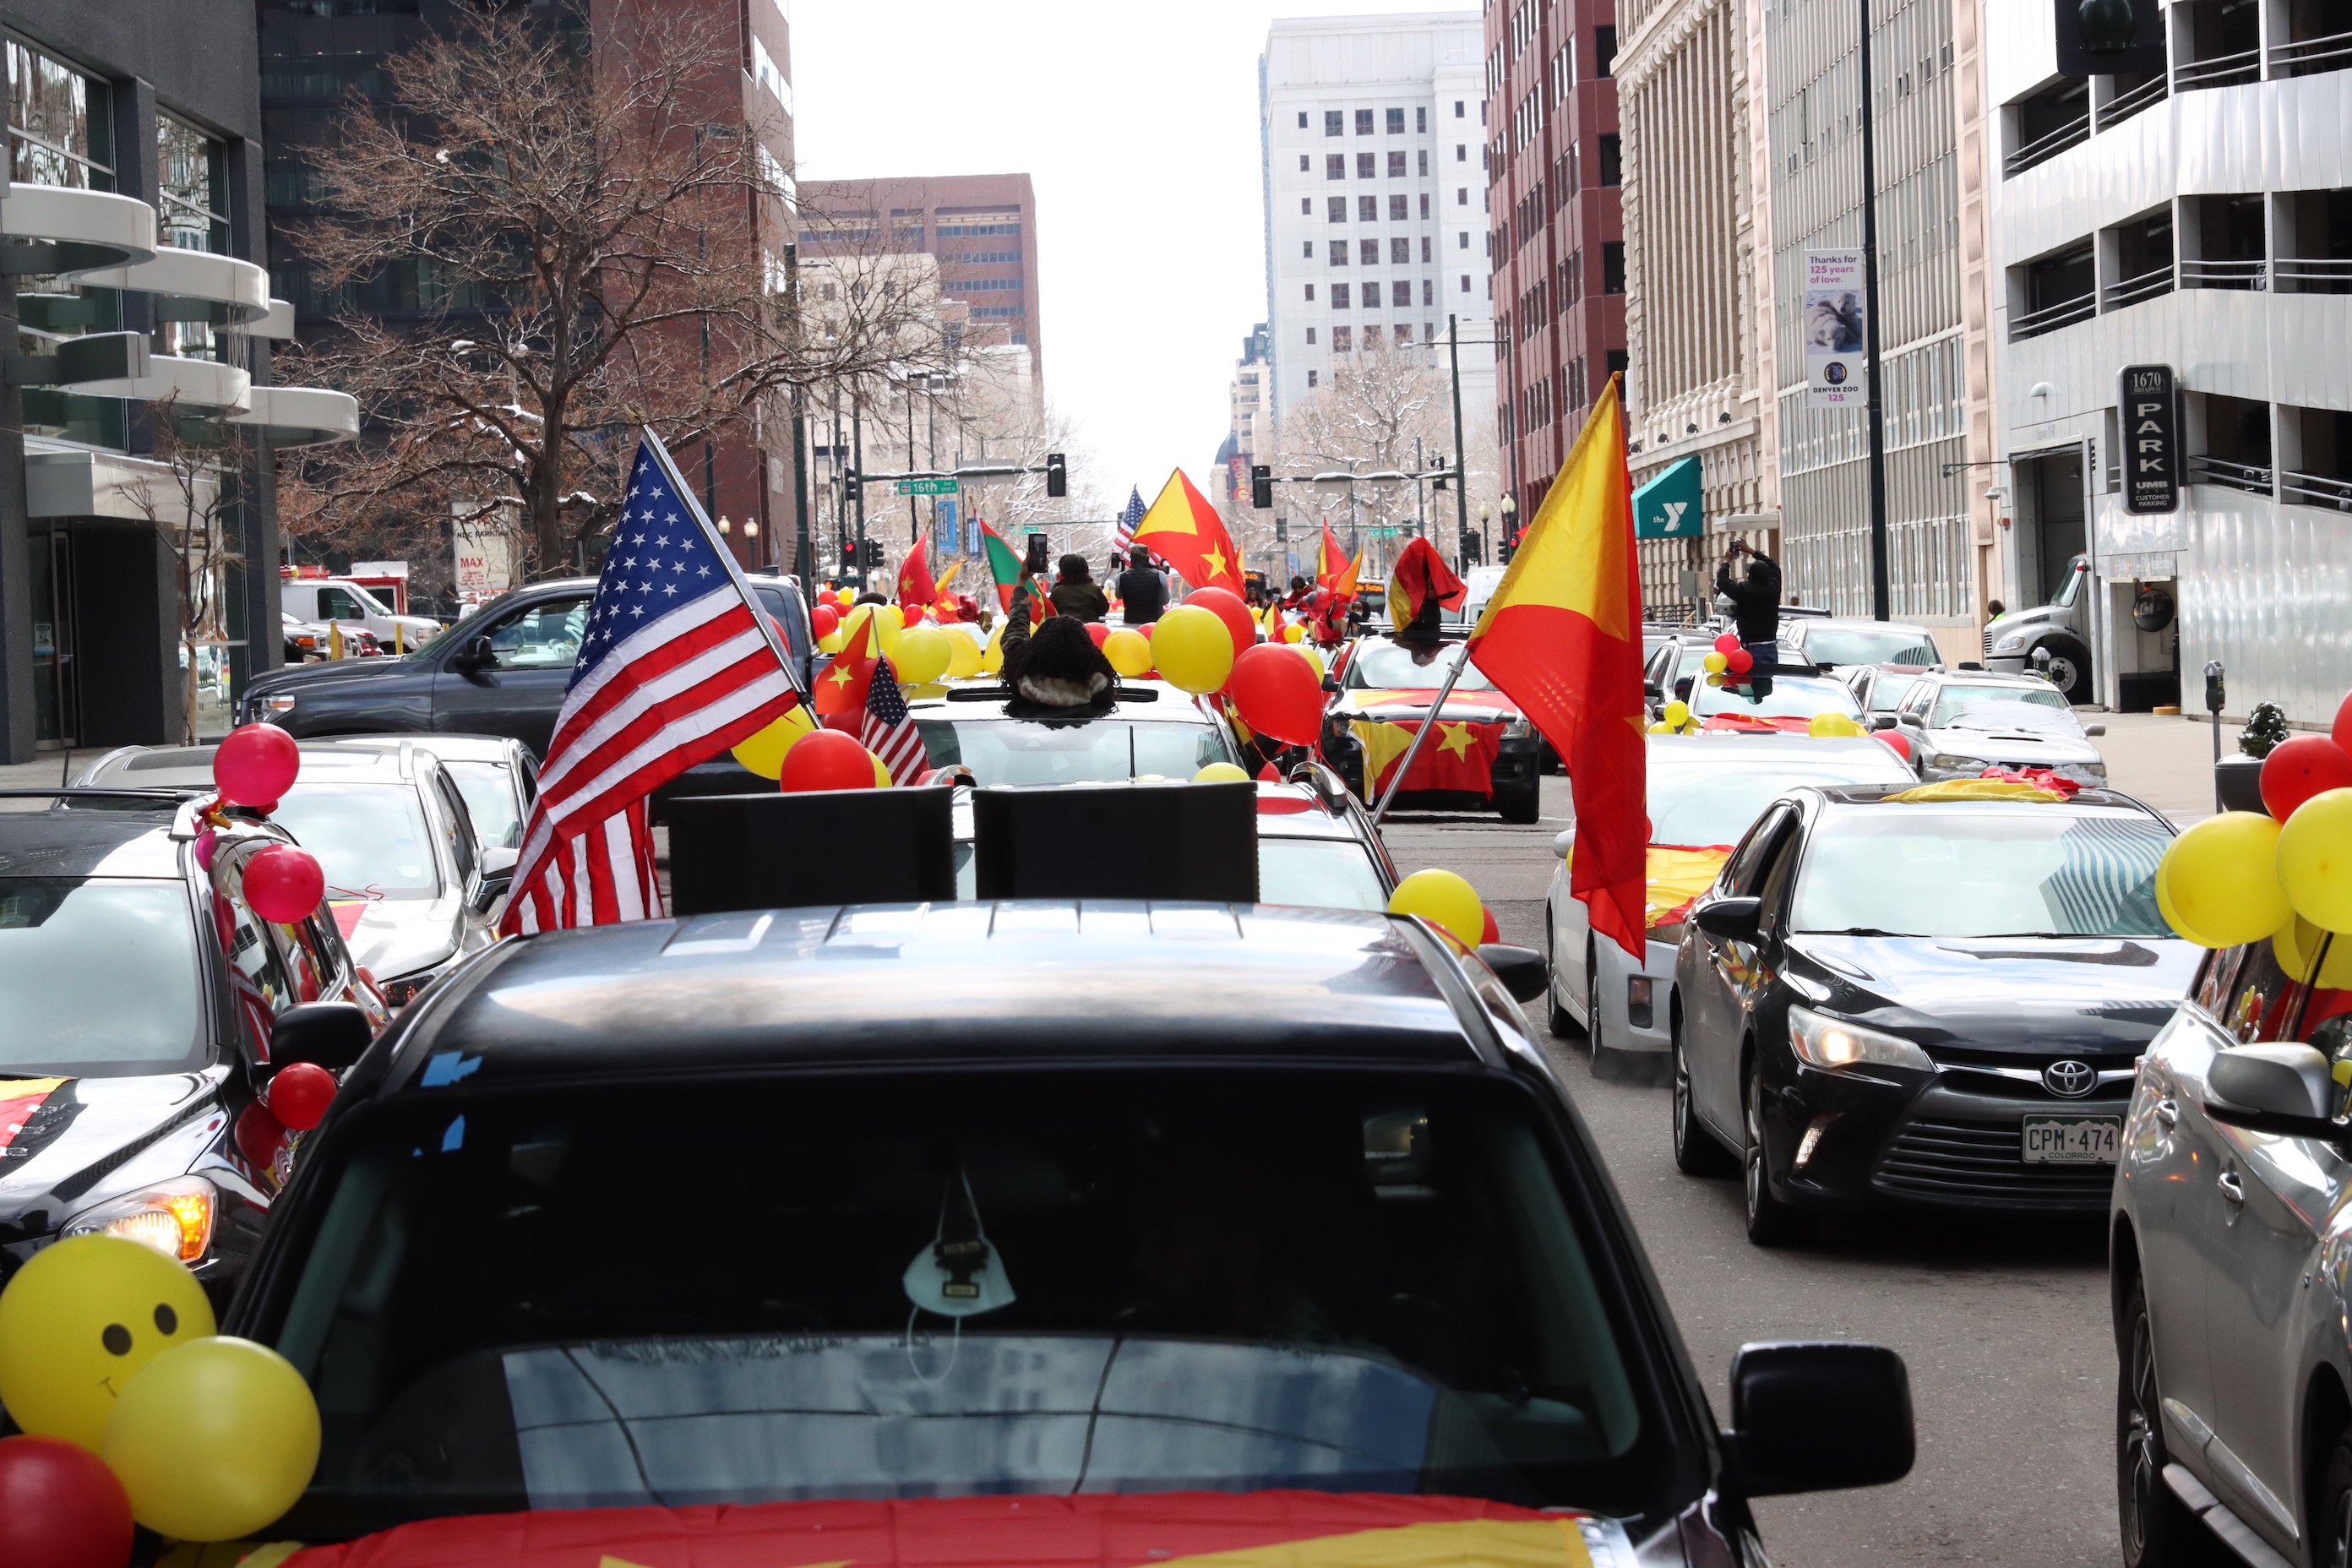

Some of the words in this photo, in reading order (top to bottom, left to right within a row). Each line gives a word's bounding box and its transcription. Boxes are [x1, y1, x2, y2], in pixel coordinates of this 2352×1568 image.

[1810, 265, 1827, 274] 125
[1830, 266, 1854, 275] years
[1810, 275, 1820, 284] of
[2133, 372, 2162, 388] 1670
[2137, 403, 2165, 472] PARK
[913, 482, 938, 493] 16th
[2136, 481, 2169, 489] UMB
[460, 558, 484, 569] MAX
